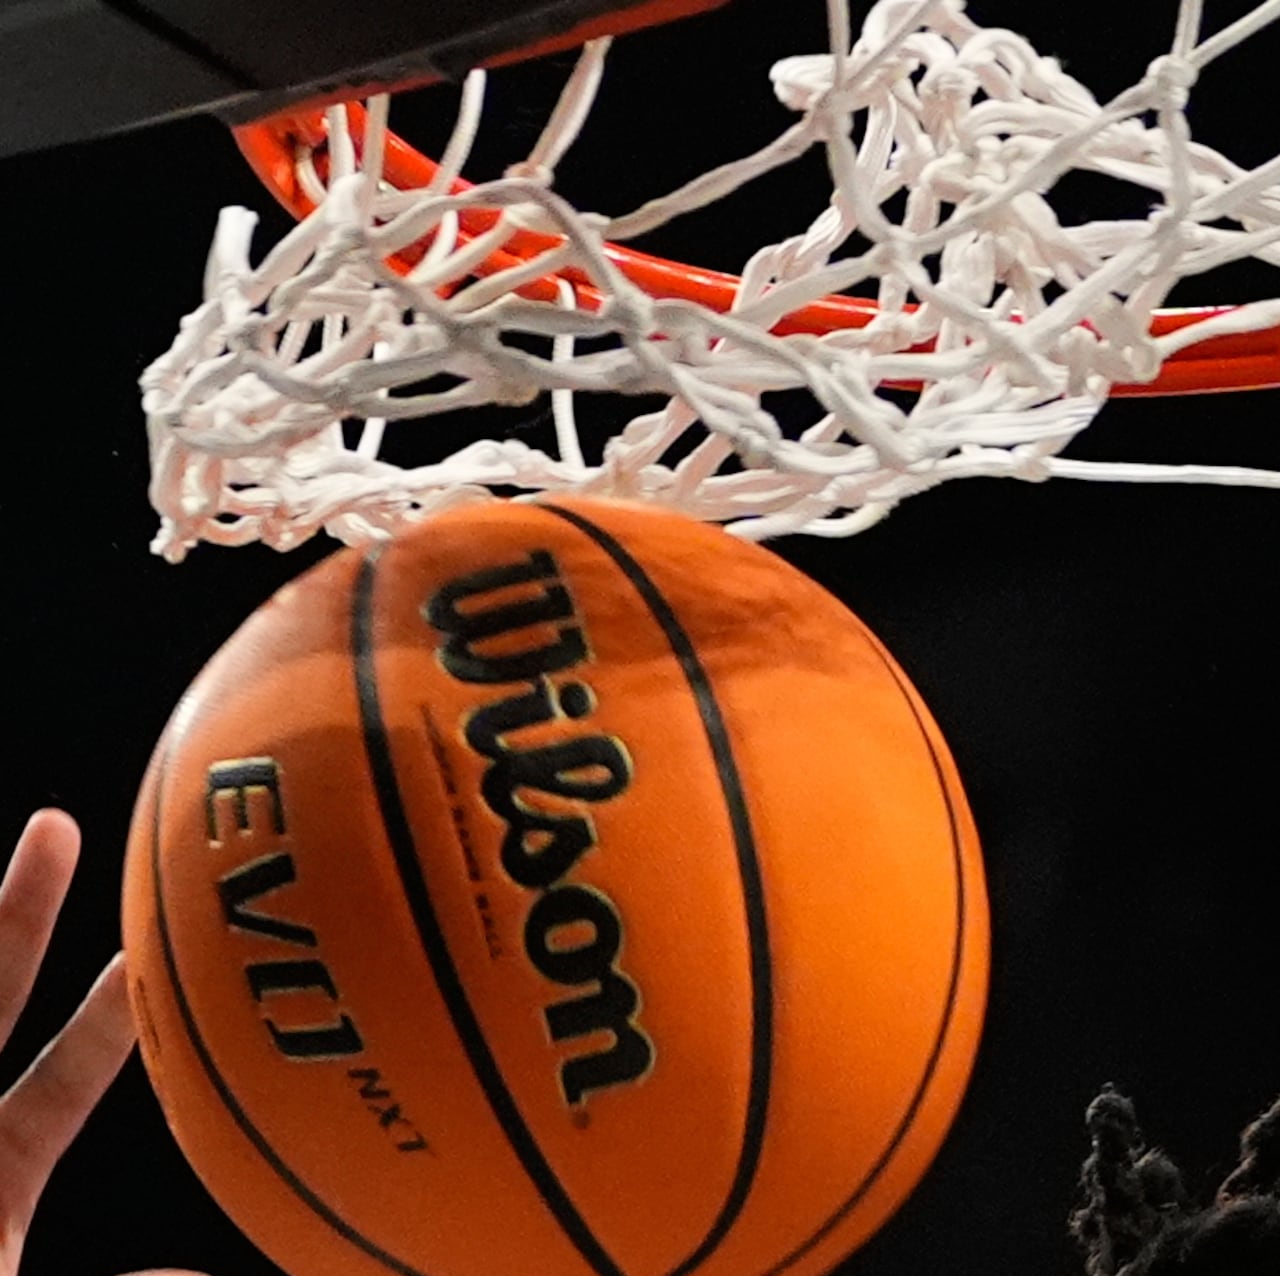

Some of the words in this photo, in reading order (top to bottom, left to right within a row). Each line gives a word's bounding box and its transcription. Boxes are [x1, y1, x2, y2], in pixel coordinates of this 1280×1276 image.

[206, 756, 366, 1064] EVO
[346, 1066, 435, 1154] NXT
[421, 547, 655, 1110] Wilson
